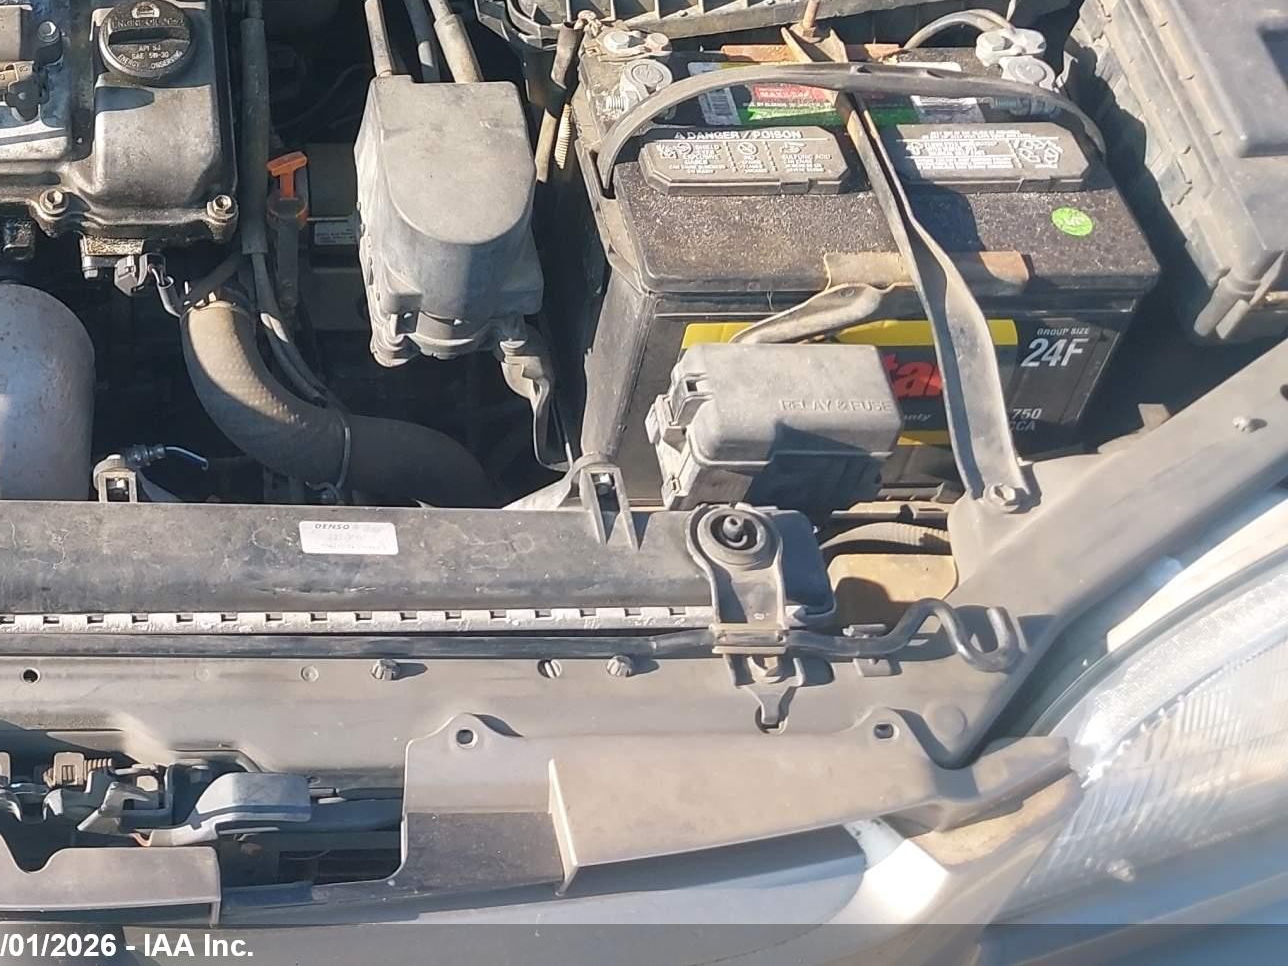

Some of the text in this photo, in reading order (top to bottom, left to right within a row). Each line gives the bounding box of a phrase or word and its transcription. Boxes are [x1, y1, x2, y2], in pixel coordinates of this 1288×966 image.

[687, 130, 741, 140] DANGER
[753, 129, 803, 139] POISON
[1037, 327, 1090, 336] GROUP SIZE
[1020, 337, 1090, 367] 24F
[779, 399, 832, 411] RELAY
[849, 399, 894, 411] FUSE
[1012, 408, 1043, 420] 750
